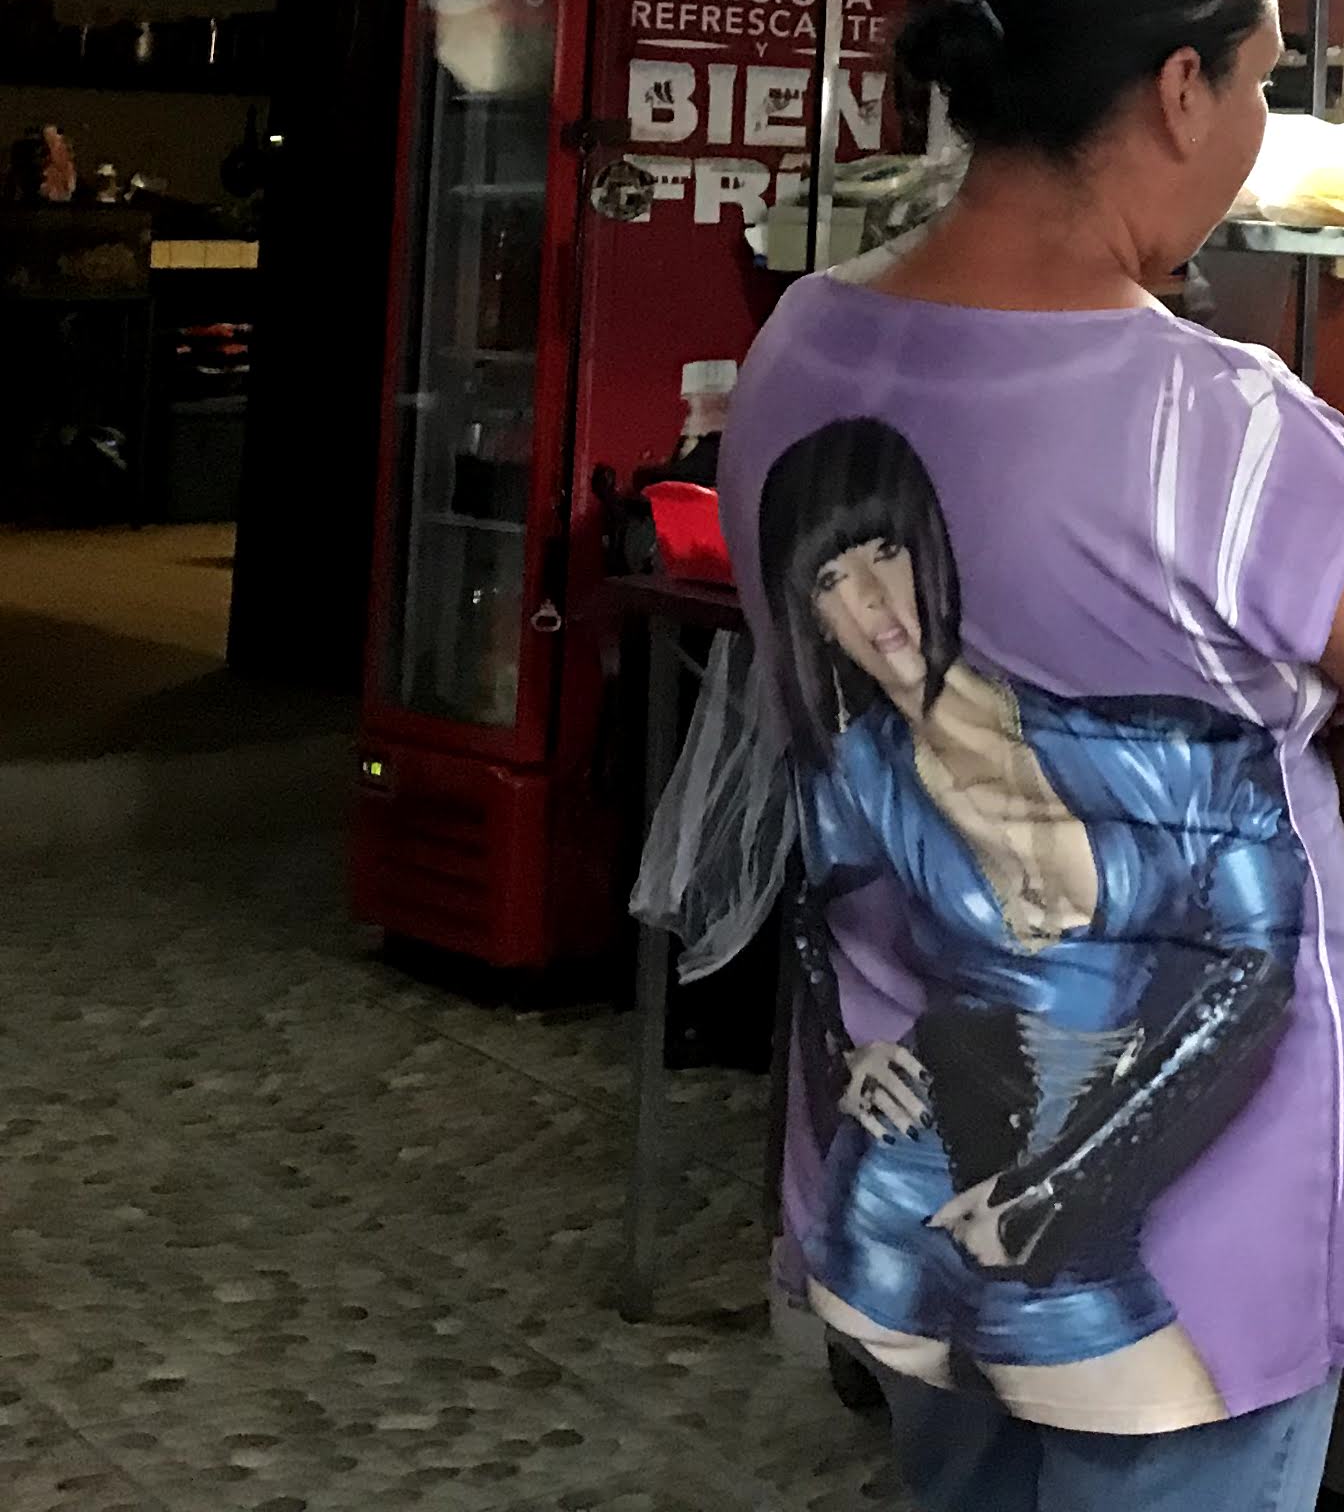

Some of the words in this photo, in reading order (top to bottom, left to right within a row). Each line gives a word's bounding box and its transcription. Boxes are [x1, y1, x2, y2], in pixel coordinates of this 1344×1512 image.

[630, 0, 888, 44] REFRESCATE
[755, 41, 769, 59] Y
[627, 58, 888, 151] BIEN
